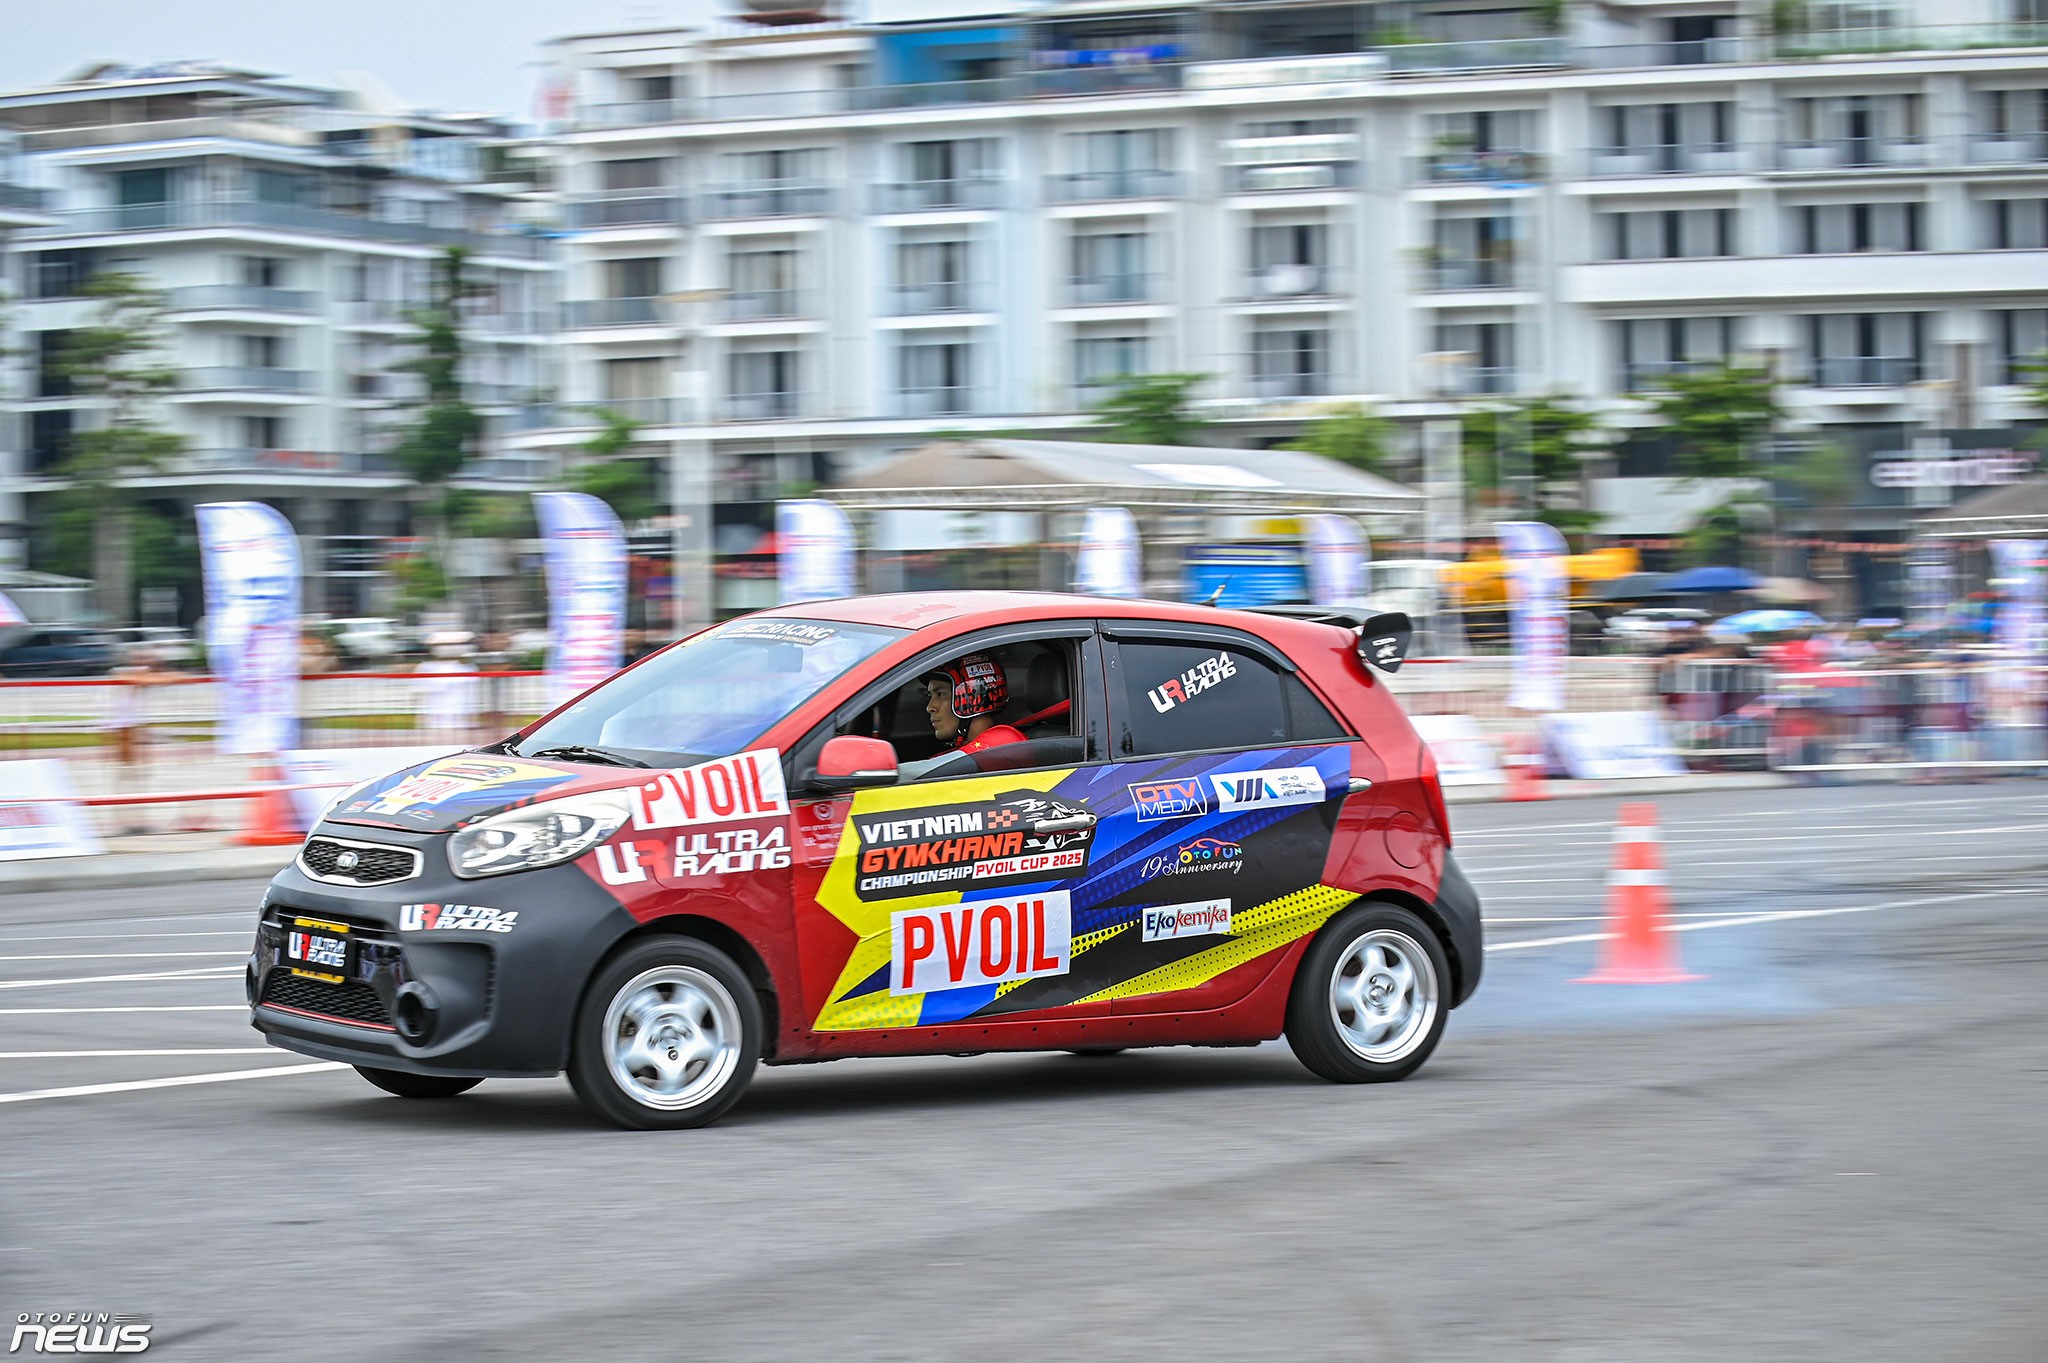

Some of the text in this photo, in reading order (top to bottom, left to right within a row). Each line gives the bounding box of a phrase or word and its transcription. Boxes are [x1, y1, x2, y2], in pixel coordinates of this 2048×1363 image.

[1181, 651, 1230, 685] ULTRA
[1184, 661, 1237, 699] RACING
[640, 756, 778, 824] PVOIL
[1135, 781, 1196, 803] OTV
[1141, 798, 1203, 817] MEDIA
[675, 826, 786, 856] ULTRA
[860, 812, 983, 844] VIETNAM
[673, 846, 792, 878] RACING
[861, 831, 1024, 874] GYMKHANA
[1162, 859, 1243, 876] Anniversary
[1180, 846, 1242, 864] OTOFUN
[859, 852, 1082, 891] CHAMPIONSHIP PVOIL CUP 2025
[434, 916, 518, 933] RACING
[440, 904, 519, 924] ULTRA
[1146, 904, 1229, 938] Ekokemika
[306, 948, 346, 967] RACING
[309, 936, 347, 955] ULTRA
[902, 899, 1060, 989] PVOIL
